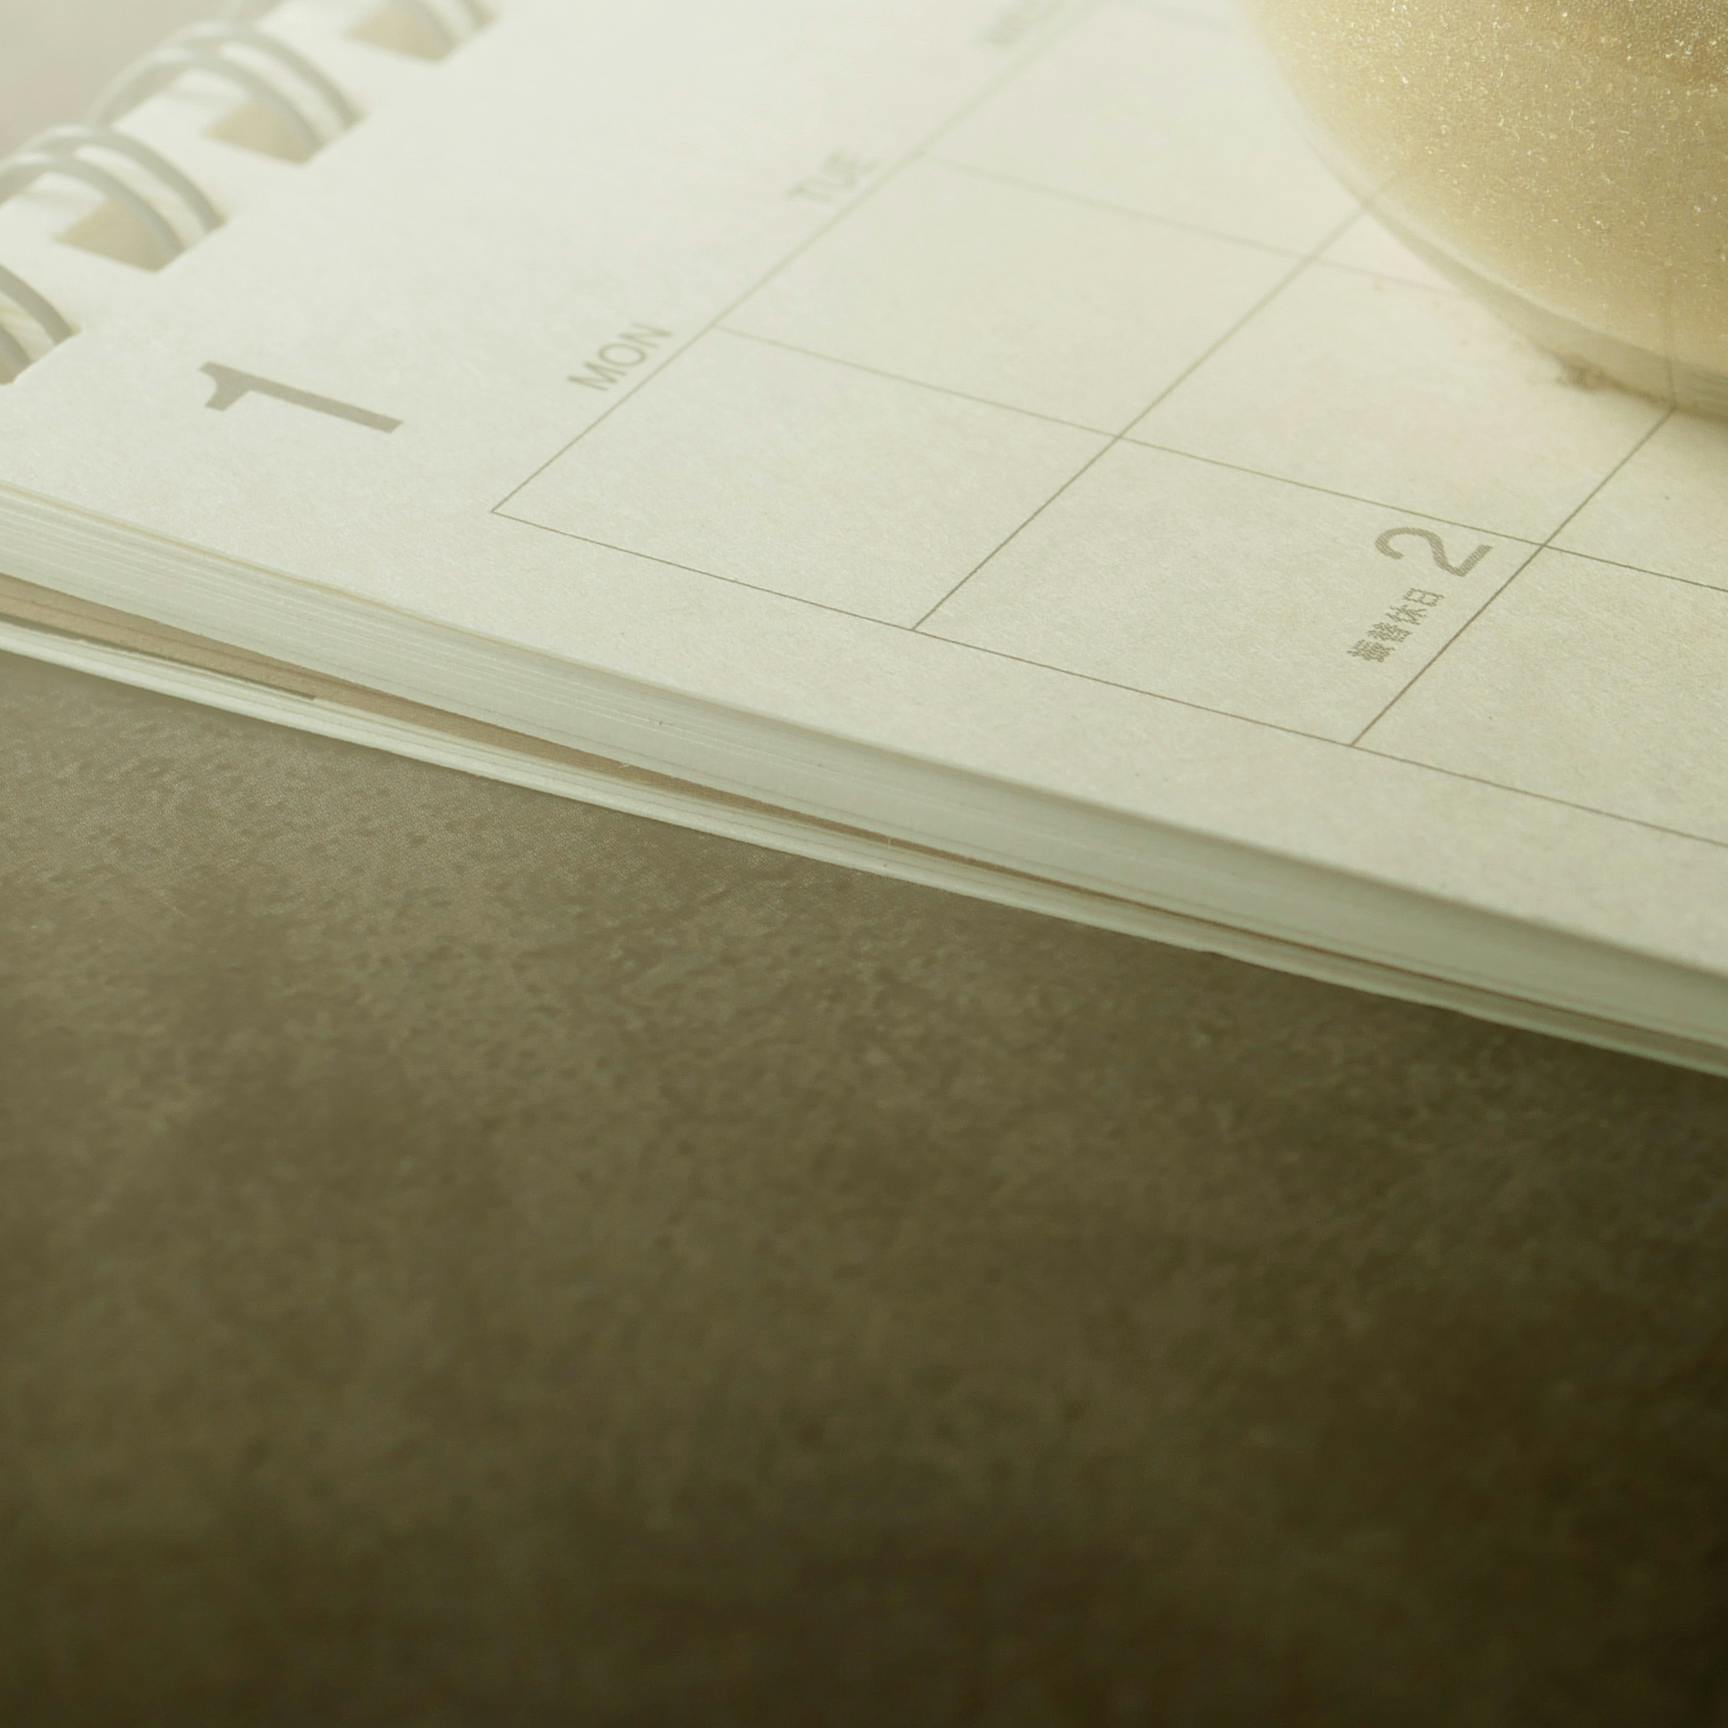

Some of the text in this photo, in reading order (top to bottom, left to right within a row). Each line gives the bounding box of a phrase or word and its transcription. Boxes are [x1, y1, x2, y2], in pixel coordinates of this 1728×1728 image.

[784, 148, 878, 204] TUE
[567, 322, 673, 392] MON
[197, 360, 404, 434] 1
[1374, 526, 1494, 577] 2
